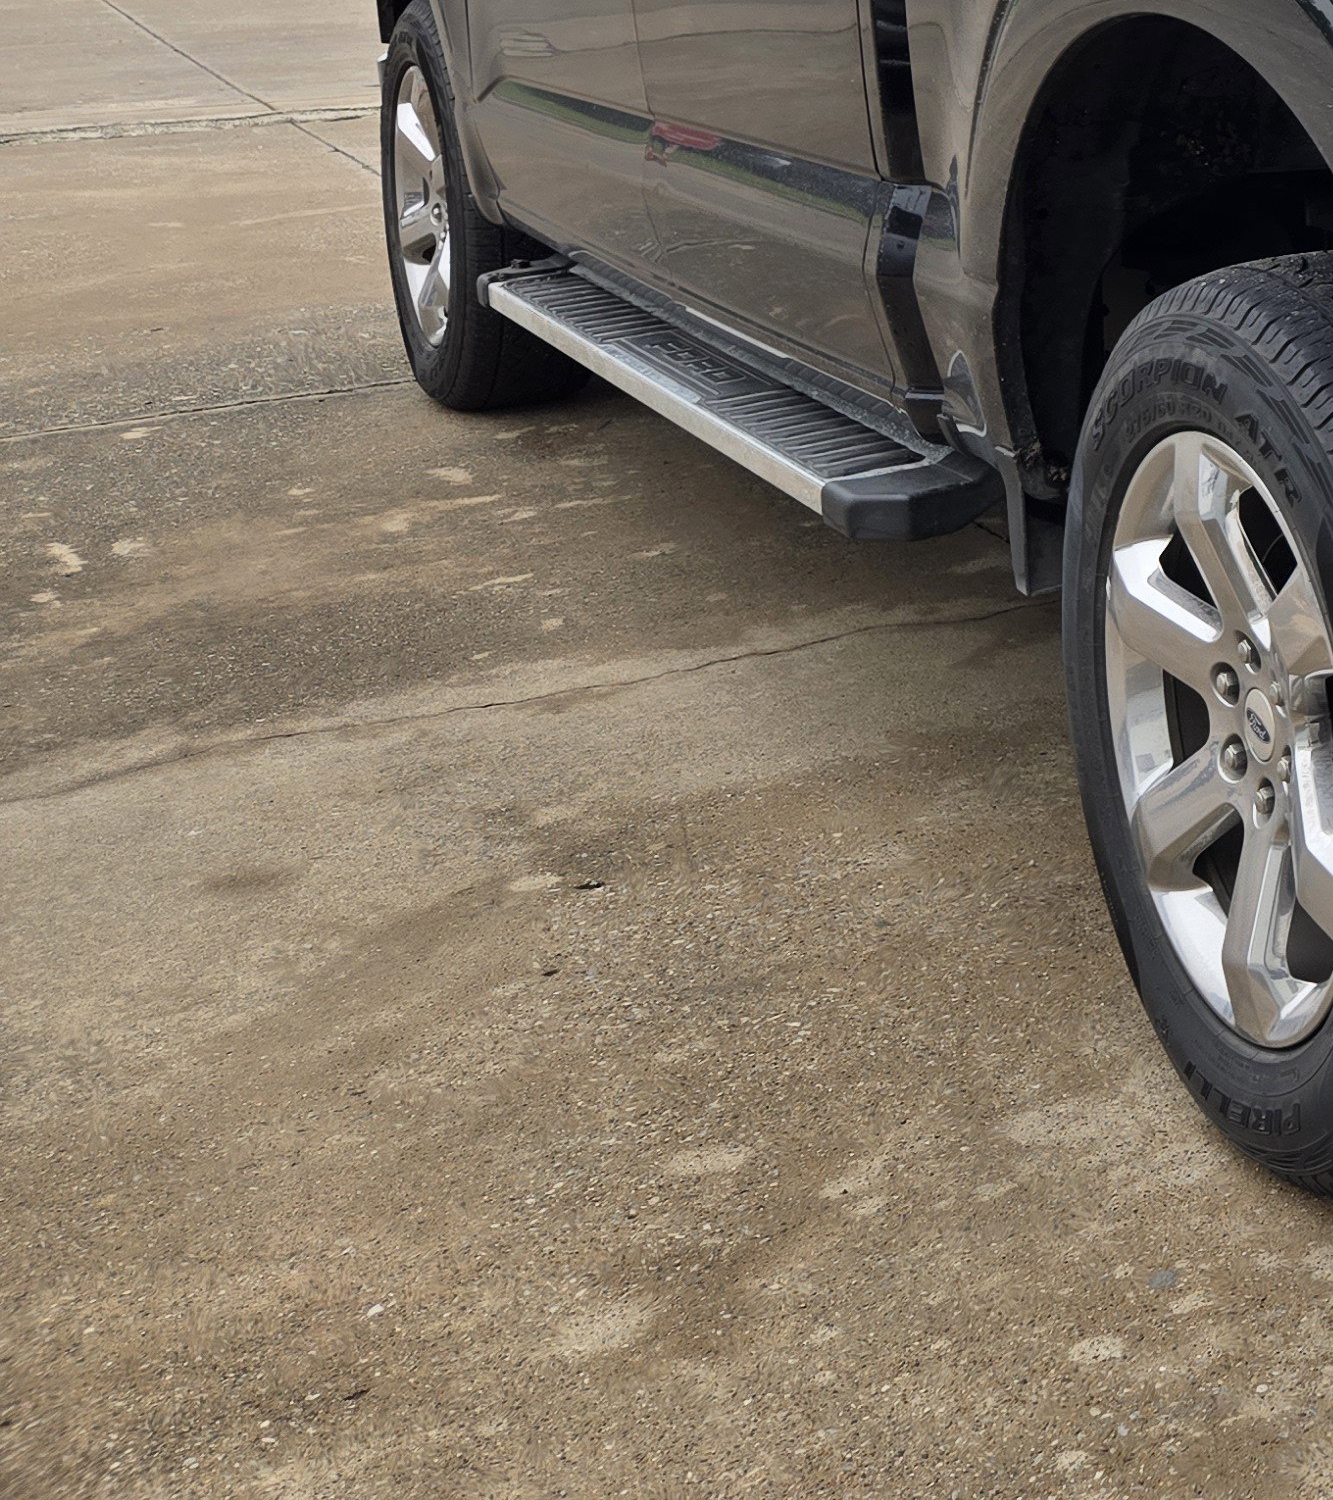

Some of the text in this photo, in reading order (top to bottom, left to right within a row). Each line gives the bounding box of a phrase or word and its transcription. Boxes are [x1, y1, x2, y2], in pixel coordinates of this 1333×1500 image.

[641, 341, 748, 386] FORD
[1092, 358, 1229, 451] SCORPION
[1235, 414, 1302, 507] ATR
[1183, 1060, 1301, 1137] PIRELLI
